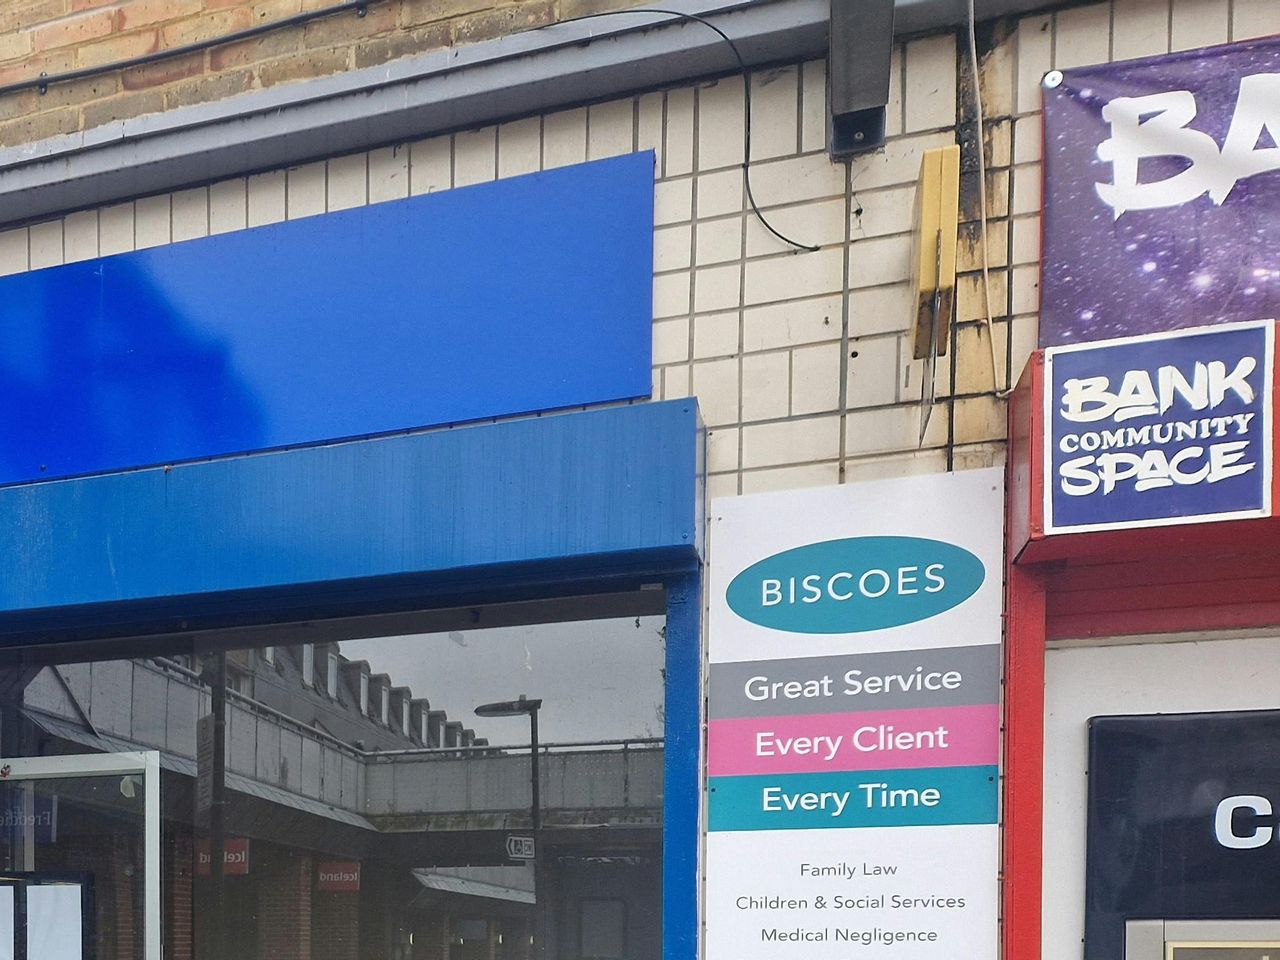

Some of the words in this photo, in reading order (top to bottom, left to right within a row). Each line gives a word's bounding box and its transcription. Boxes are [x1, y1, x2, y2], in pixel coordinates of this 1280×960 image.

[1060, 356, 1258, 423] BANK
[1059, 412, 1256, 454] COMMUNITY
[1059, 440, 1256, 497] SPACE
[761, 562, 945, 607] BISCOES
[744, 675, 834, 701] Great
[843, 666, 962, 696] Service
[756, 731, 844, 761] Every
[852, 724, 949, 752] Client
[762, 787, 850, 817] Every
[858, 783, 941, 808] Time
[1215, 795, 1280, 849] C
[800, 862, 856, 880] Family
[863, 862, 898, 876] Law
[736, 895, 808, 910] Children
[814, 895, 827, 910] &
[833, 894, 884, 909] Social
[891, 894, 966, 909] Services
[761, 927, 828, 942] Medical
[835, 927, 938, 946] Negligence
